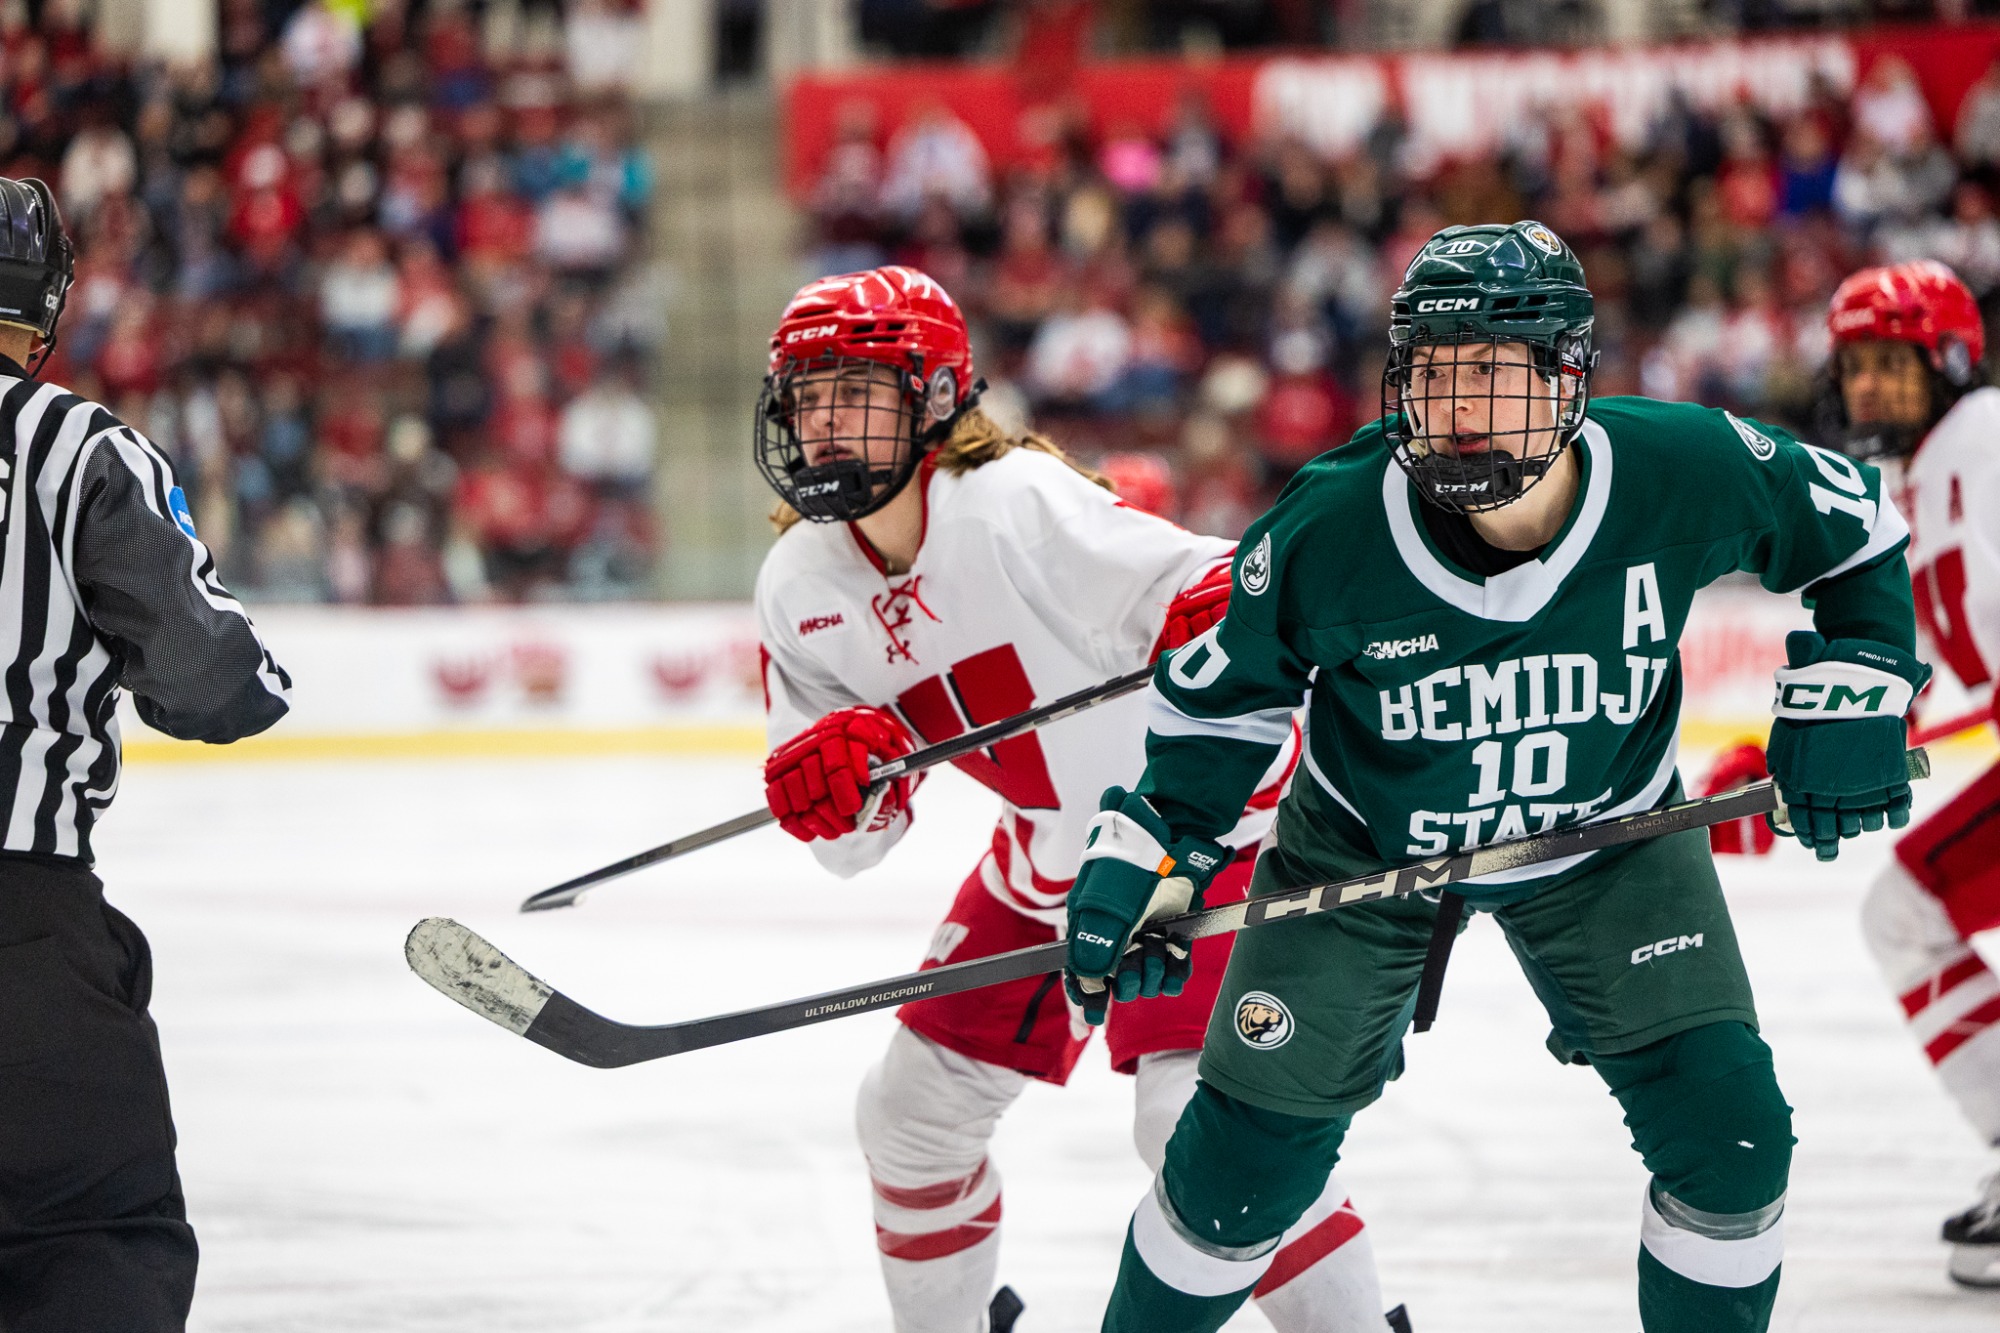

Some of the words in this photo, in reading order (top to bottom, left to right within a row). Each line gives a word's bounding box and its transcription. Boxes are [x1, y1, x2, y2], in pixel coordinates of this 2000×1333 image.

[1446, 240, 1477, 254] 10
[1417, 297, 1480, 313] CCM
[786, 324, 839, 344] CCM
[1796, 441, 1877, 545] 10
[1623, 562, 1666, 650] A
[799, 612, 844, 636] WCHA
[1376, 633, 1439, 660] WCHA
[1468, 730, 1569, 807] 10
[1625, 811, 1692, 832] NANOLITE
[1189, 851, 1219, 867] CCM
[1244, 853, 1473, 926] CCM
[1077, 931, 1114, 948] CCM
[1630, 933, 1704, 965] CCM
[805, 996, 869, 1018] ULTRALOW
[870, 982, 935, 1004] KICKPOINT
